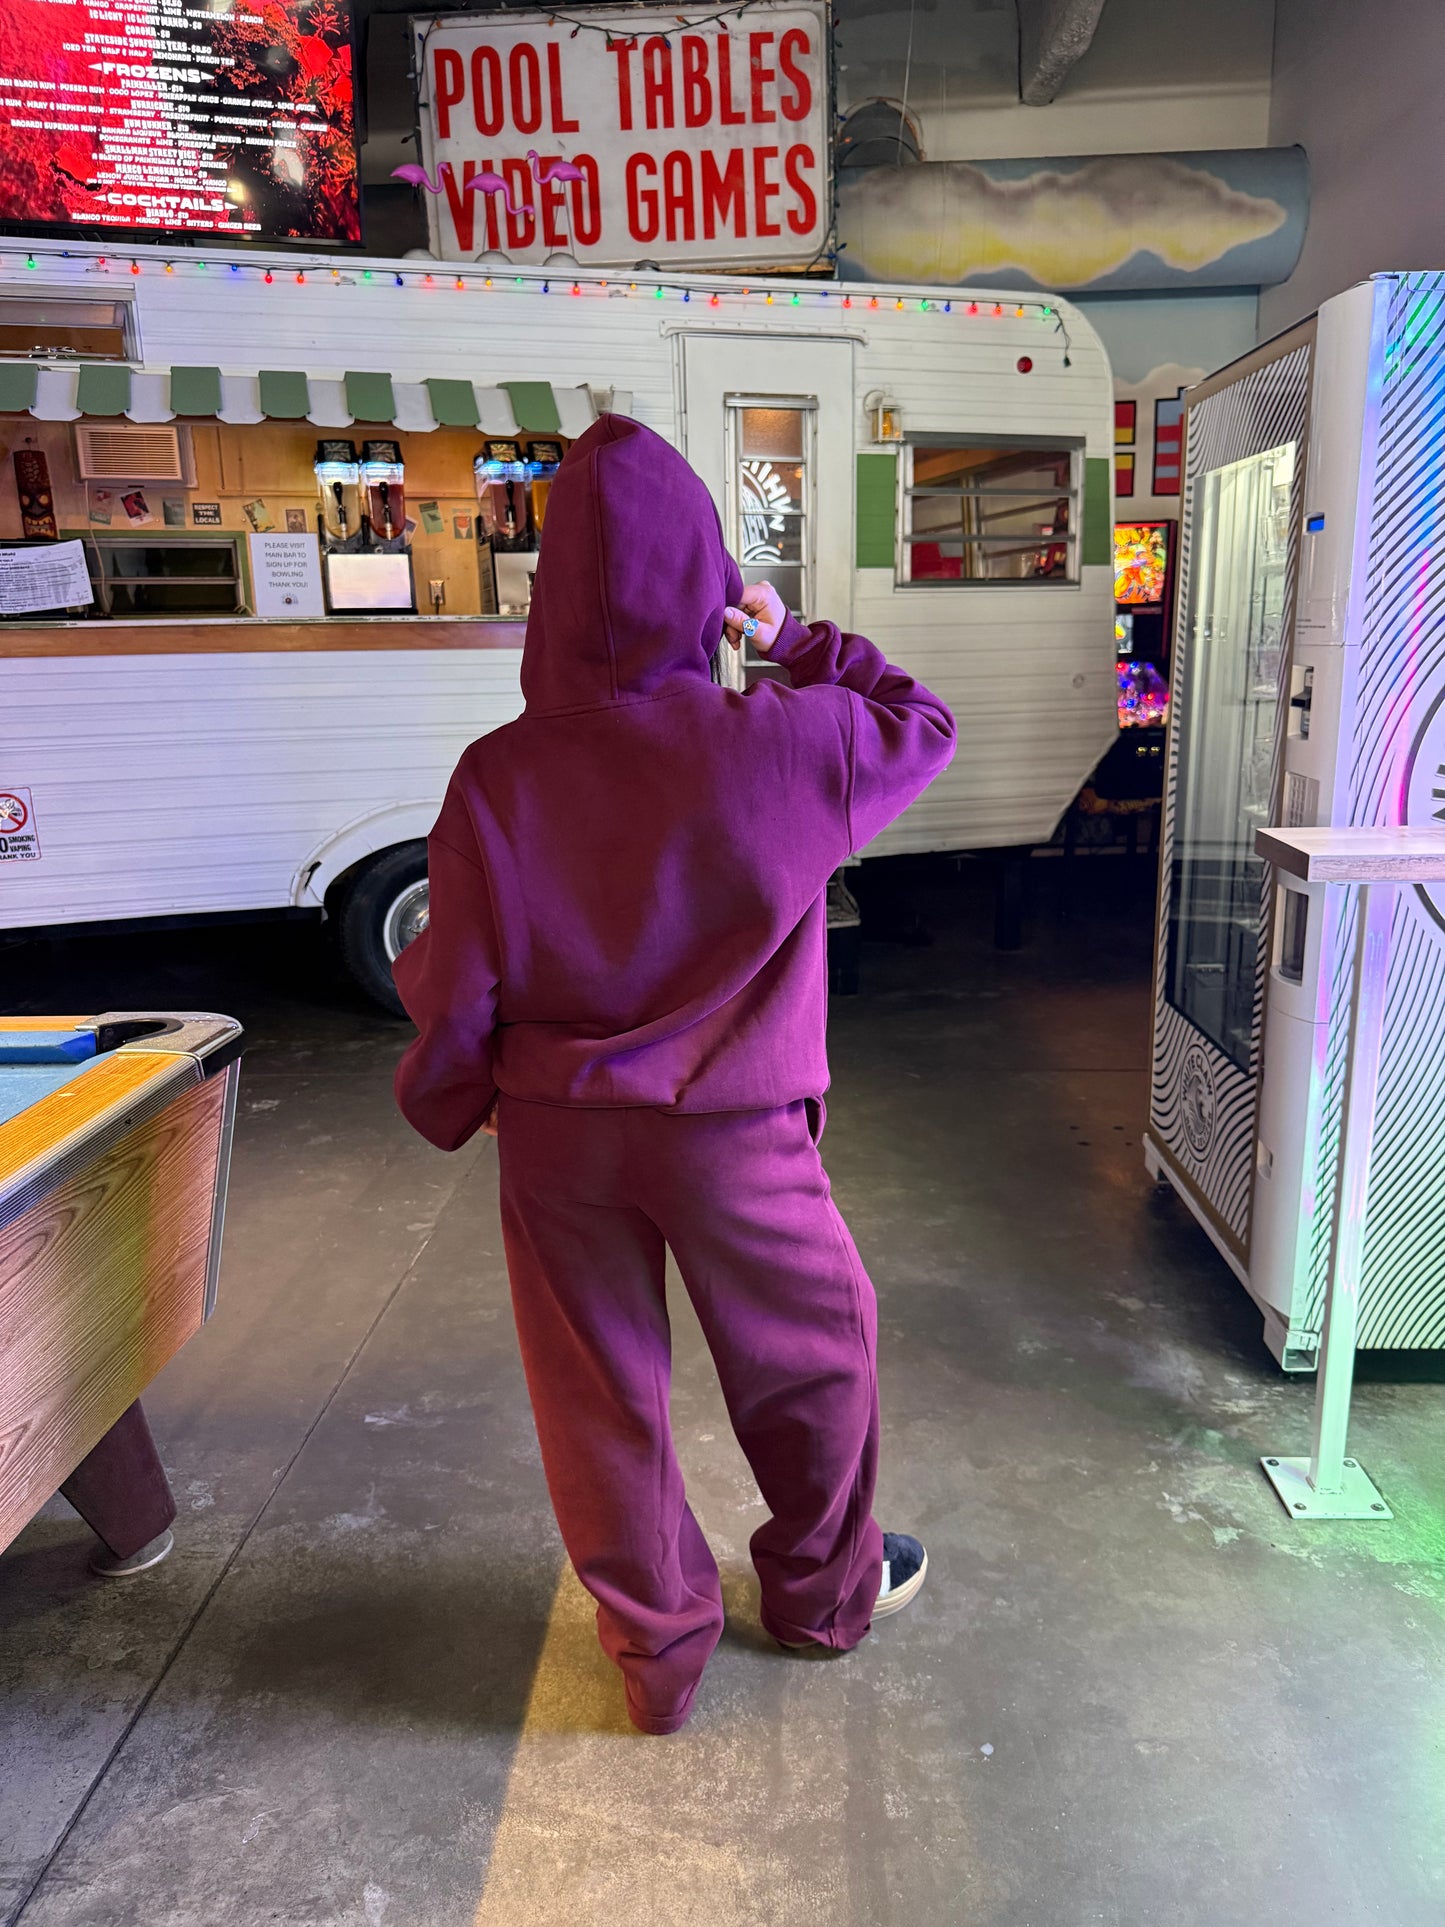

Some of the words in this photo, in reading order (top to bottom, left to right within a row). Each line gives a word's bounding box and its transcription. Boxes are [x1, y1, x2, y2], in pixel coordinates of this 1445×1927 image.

[103, 62, 200, 83] FROZENS
[434, 42, 580, 139] POOL
[605, 28, 812, 131] TABLES
[108, 193, 224, 211] COCKTAILS
[446, 153, 602, 252] VIDEO
[625, 143, 818, 243] GAMES
[8, 835, 35, 843] SMOKING
[1182, 1054, 1195, 1100] WHITE
[1196, 1054, 1213, 1095] CLAW
